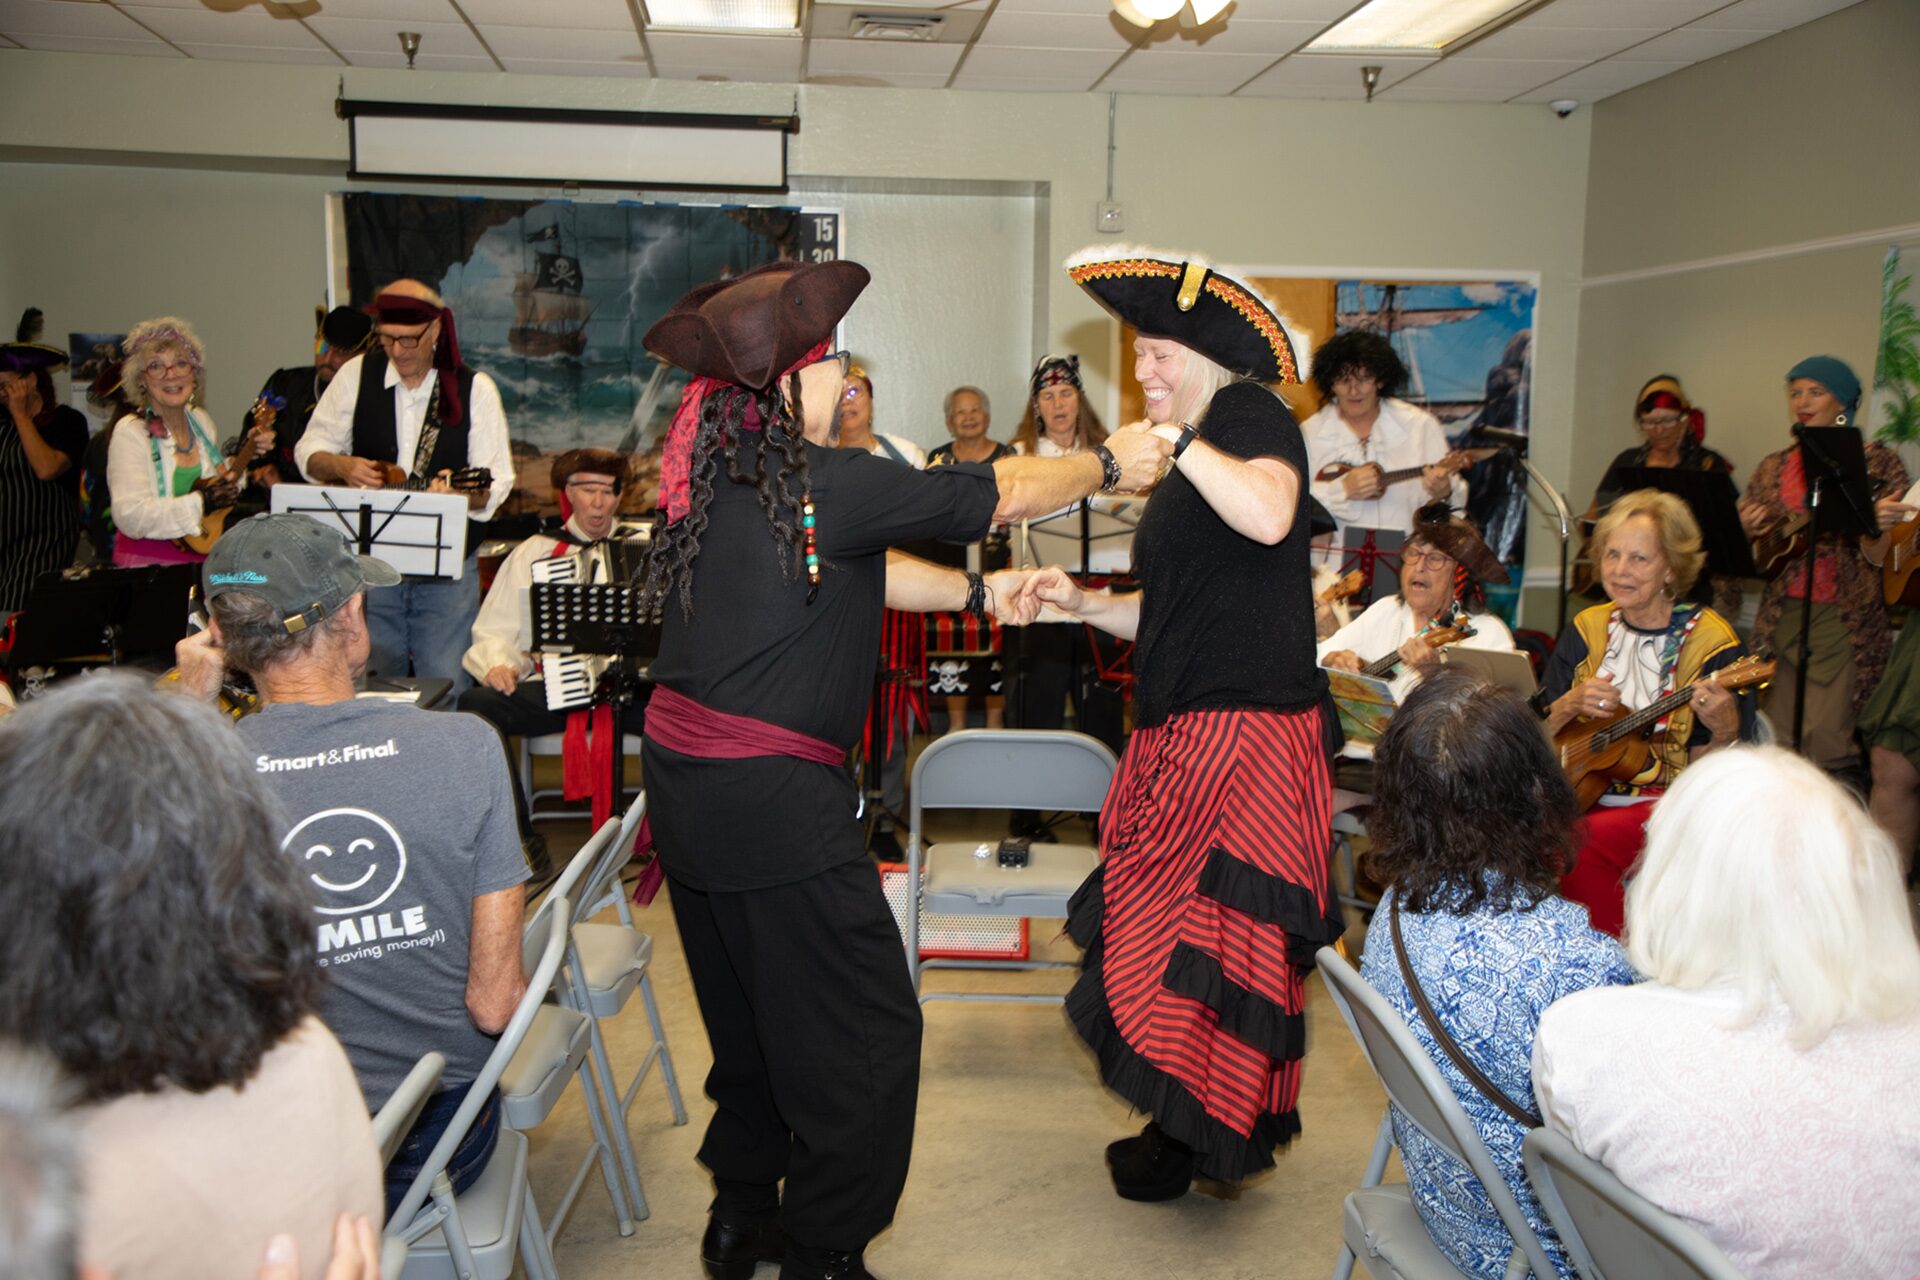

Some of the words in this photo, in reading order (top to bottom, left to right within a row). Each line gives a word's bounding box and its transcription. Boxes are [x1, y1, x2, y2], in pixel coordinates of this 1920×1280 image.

[813, 217, 834, 242] 15
[317, 905, 427, 952] MILE
[333, 945, 383, 965] saving
